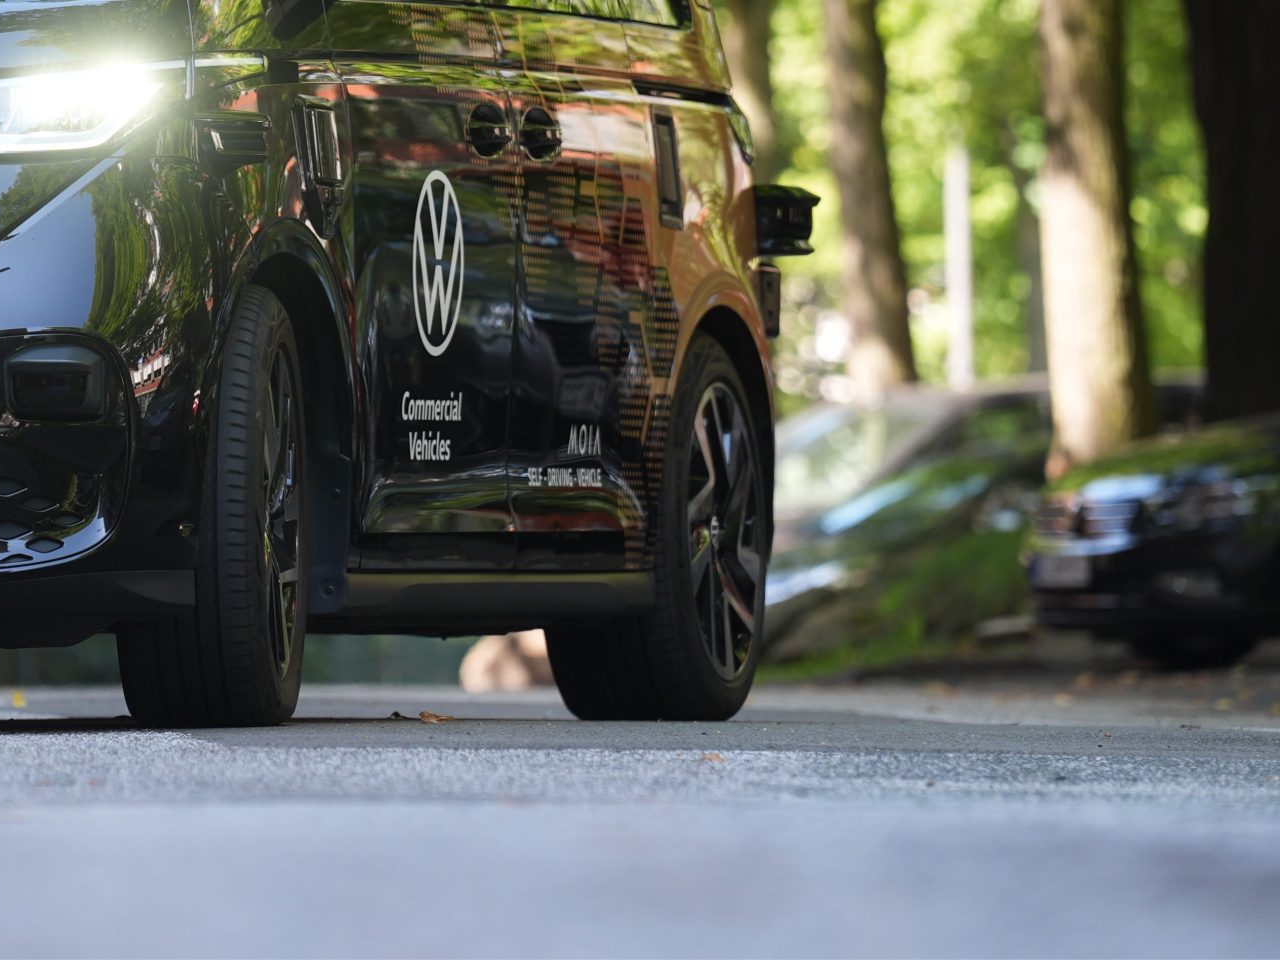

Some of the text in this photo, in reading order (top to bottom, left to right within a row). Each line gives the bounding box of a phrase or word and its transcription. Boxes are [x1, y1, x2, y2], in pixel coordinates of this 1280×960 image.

[401, 390, 463, 421] Commercial
[408, 430, 451, 461] Vehicles
[547, 467, 574, 488] DRIVING
[576, 468, 603, 488] VEHICLE
